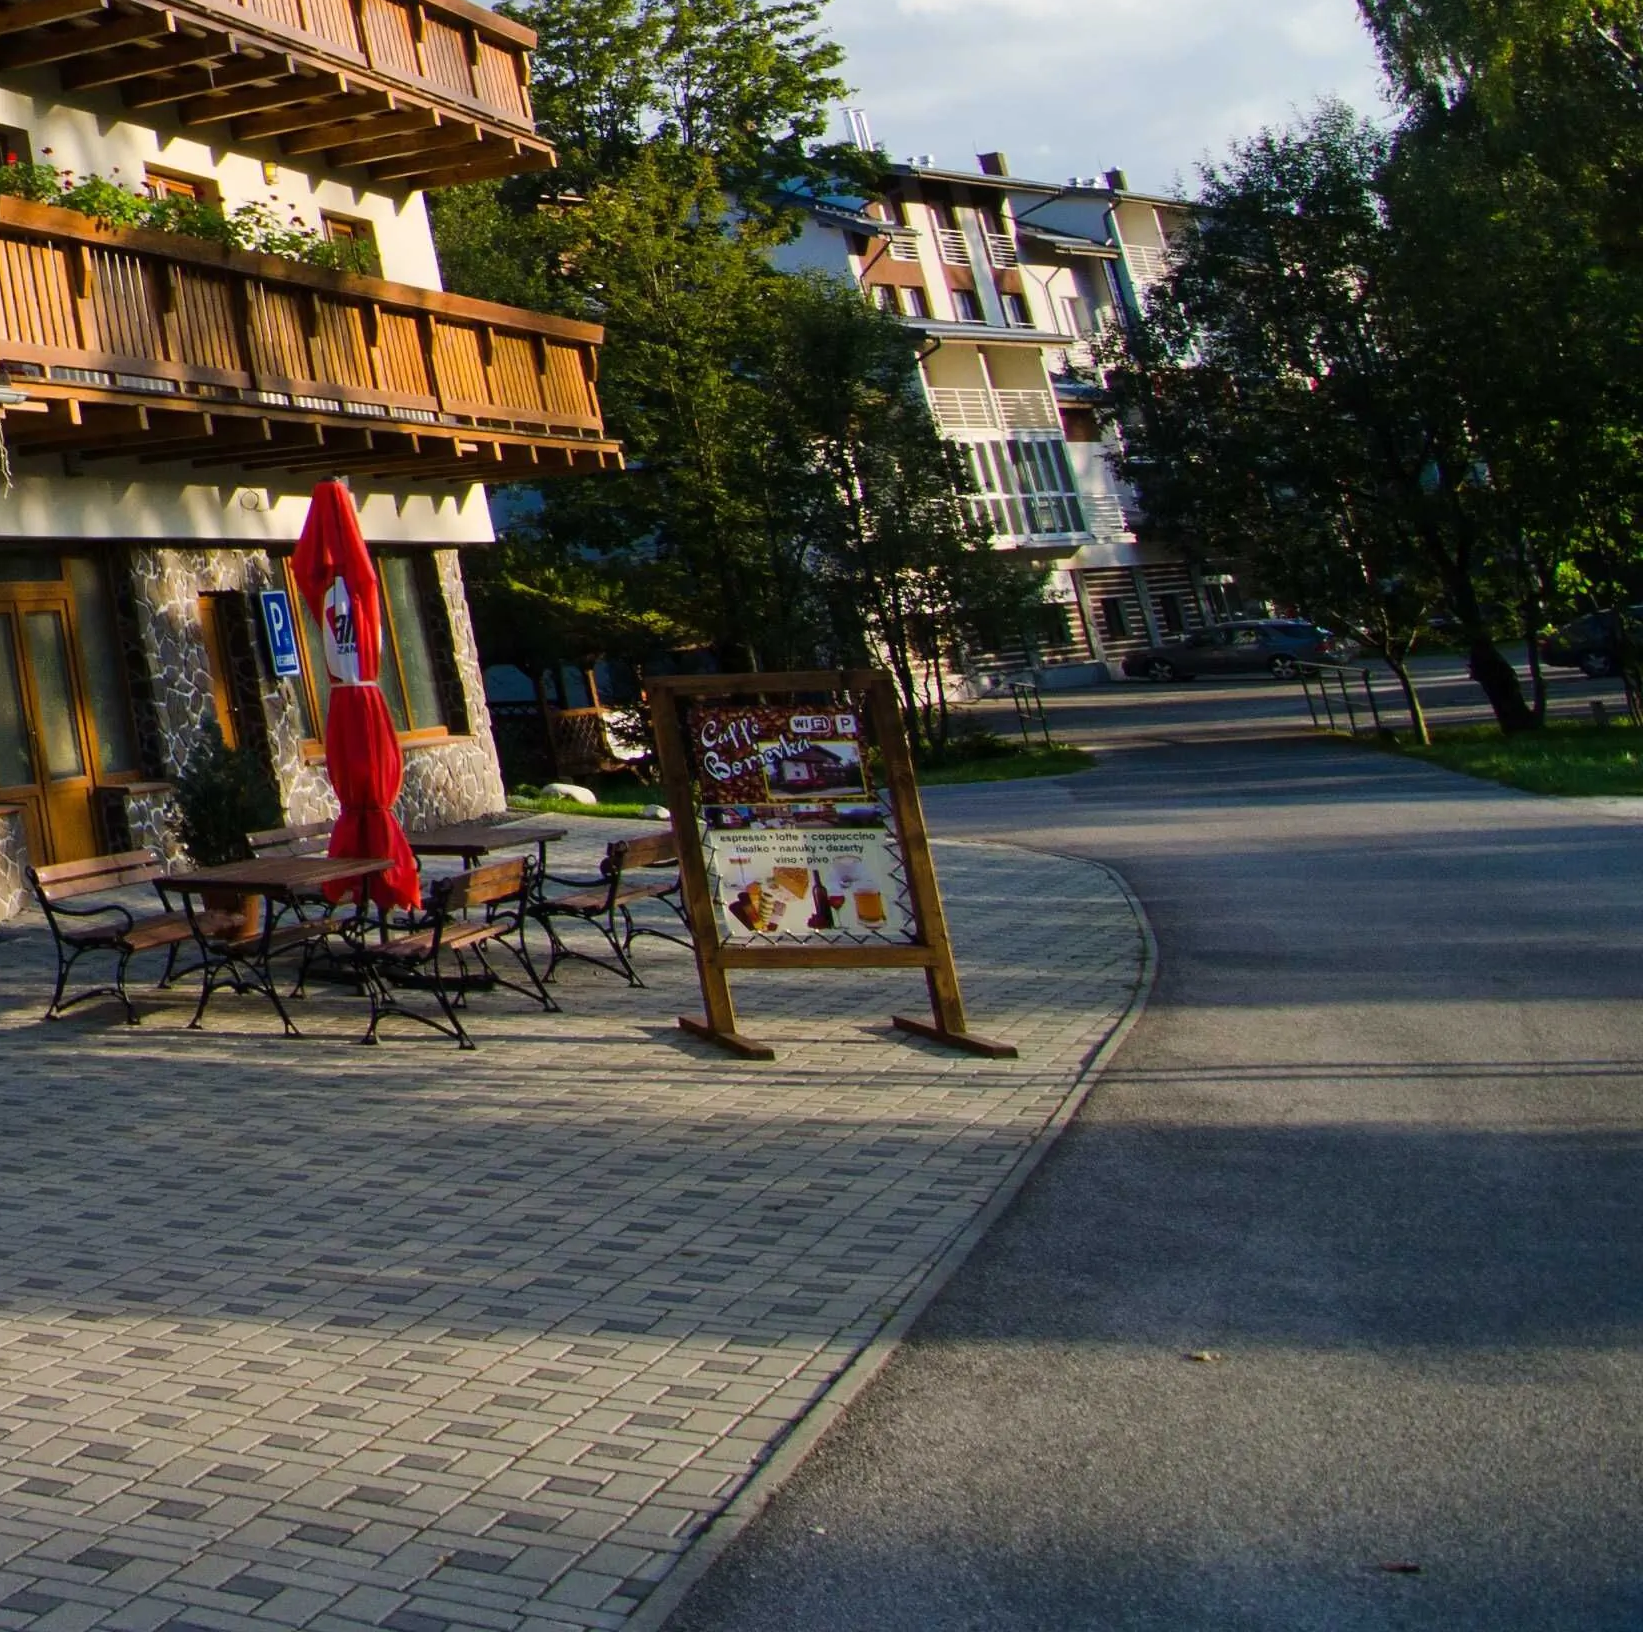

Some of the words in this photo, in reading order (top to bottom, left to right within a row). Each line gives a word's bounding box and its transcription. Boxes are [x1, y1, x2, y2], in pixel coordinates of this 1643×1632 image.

[269, 601, 284, 647] P
[840, 718, 852, 730] P
[719, 834, 767, 843] espresso
[811, 831, 876, 843] cappuccino
[779, 844, 816, 855] nanuky
[825, 843, 864, 855] dezerty
